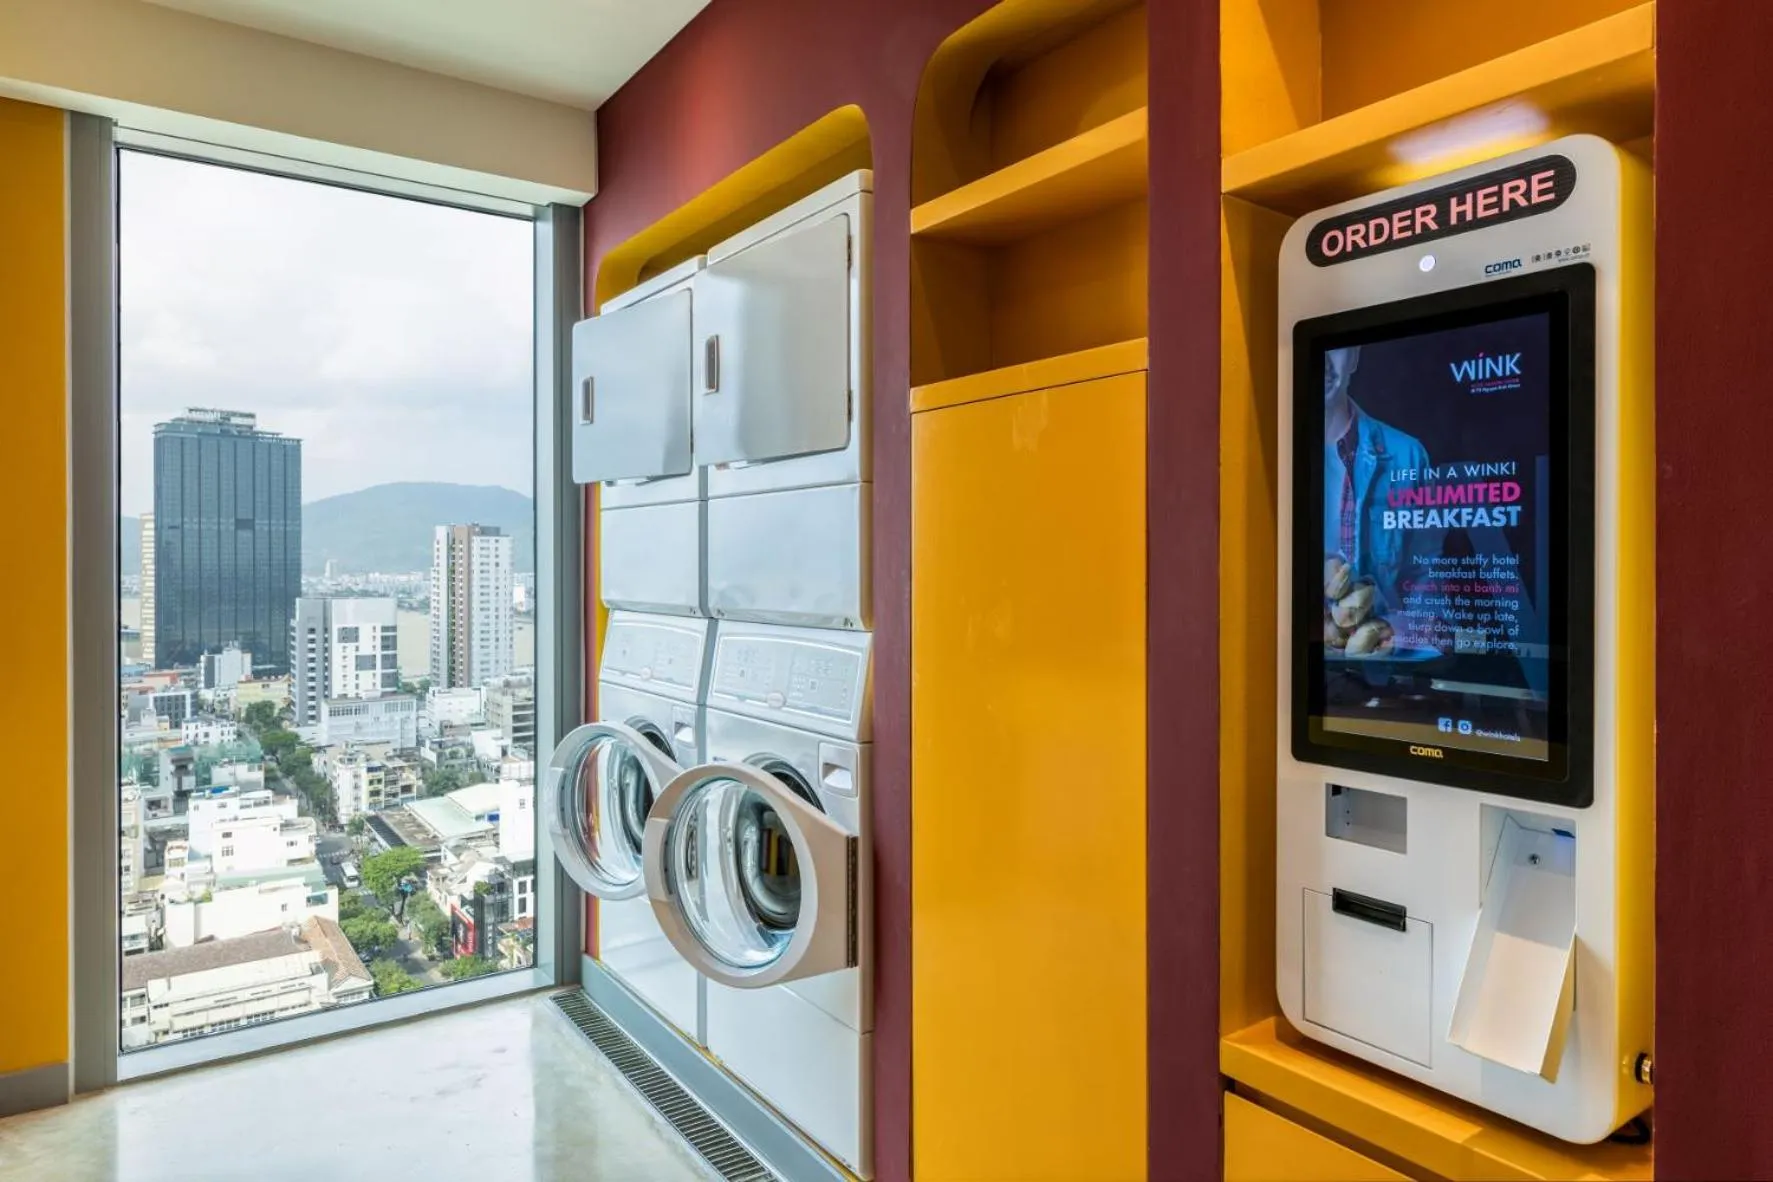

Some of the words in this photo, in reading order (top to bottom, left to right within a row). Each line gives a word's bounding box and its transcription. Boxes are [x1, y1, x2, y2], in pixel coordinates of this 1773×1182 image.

[1320, 203, 1438, 258] ORDER
[1449, 169, 1556, 226] HERE
[1390, 468, 1417, 482] LIFE
[1424, 467, 1440, 480] IN
[1446, 466, 1458, 478] A
[1464, 461, 1516, 477] WINK!
[1387, 482, 1521, 507] UNLIMITED
[1383, 505, 1522, 530] BREAKFAST
[1413, 555, 1429, 565] No
[1431, 557, 1458, 565] more
[1461, 554, 1488, 567] stuffy
[1492, 554, 1519, 565] hotel
[1428, 568, 1476, 579] breakfast
[1479, 568, 1519, 580] buffets.
[1454, 595, 1471, 606] the
[1474, 597, 1519, 611] morning
[1442, 610, 1474, 620] Wake
[1477, 613, 1491, 624] up
[1507, 624, 1520, 636] of
